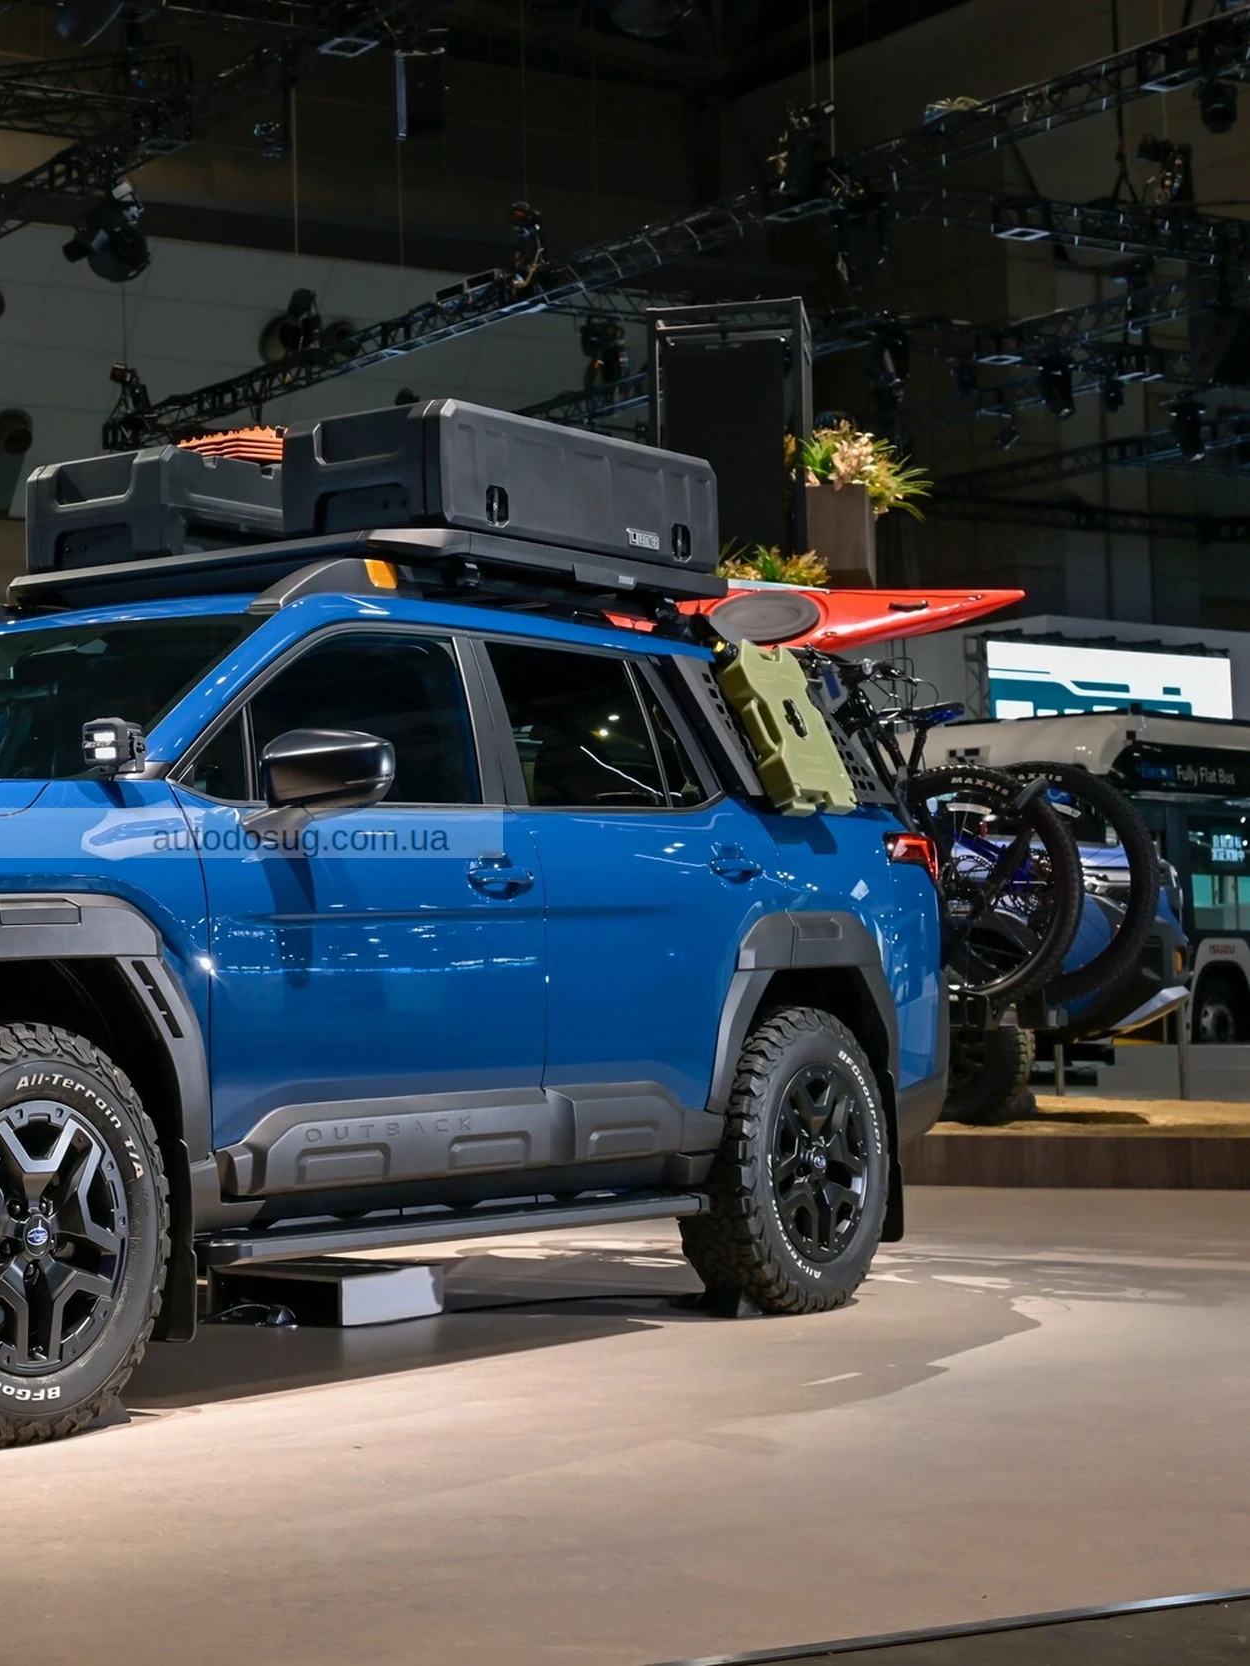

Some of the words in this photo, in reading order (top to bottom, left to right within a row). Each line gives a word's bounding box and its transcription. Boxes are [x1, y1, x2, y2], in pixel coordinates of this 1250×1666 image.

[951, 776, 1010, 796] MAXXIS
[1017, 772, 1063, 783] AXXIS
[1176, 764, 1199, 787] Fully
[1199, 766, 1218, 783] Flat
[1218, 768, 1236, 785] Bus
[1209, 943, 1236, 955] ISUZU
[838, 1050, 882, 1155] BFGoodrich
[16, 1073, 122, 1129] All-Terrain
[123, 1135, 145, 1179] T/A
[304, 1115, 473, 1143] OUTBACK
